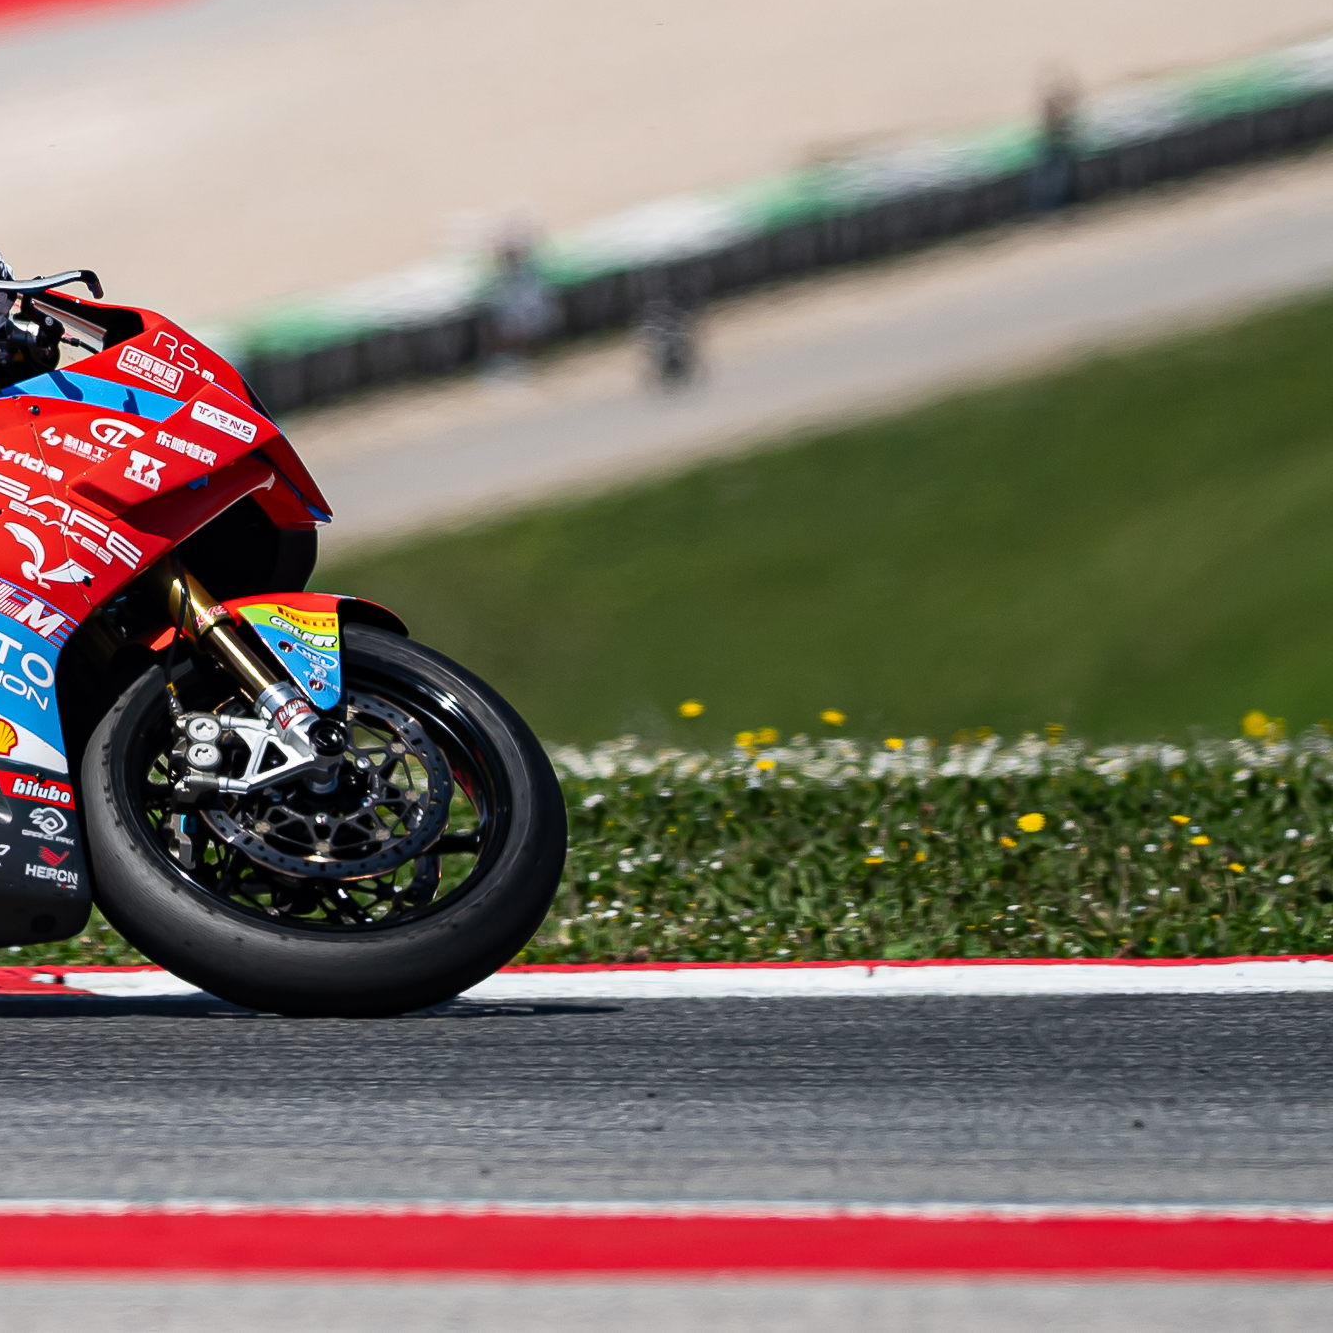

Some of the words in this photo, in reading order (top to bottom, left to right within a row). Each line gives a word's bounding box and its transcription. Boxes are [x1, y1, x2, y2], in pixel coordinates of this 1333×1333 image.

[125, 350, 179, 385] 中国制造
[8, 499, 113, 565] BRAKES
[270, 615, 338, 648] GALFER
[12, 778, 72, 804] bitubo
